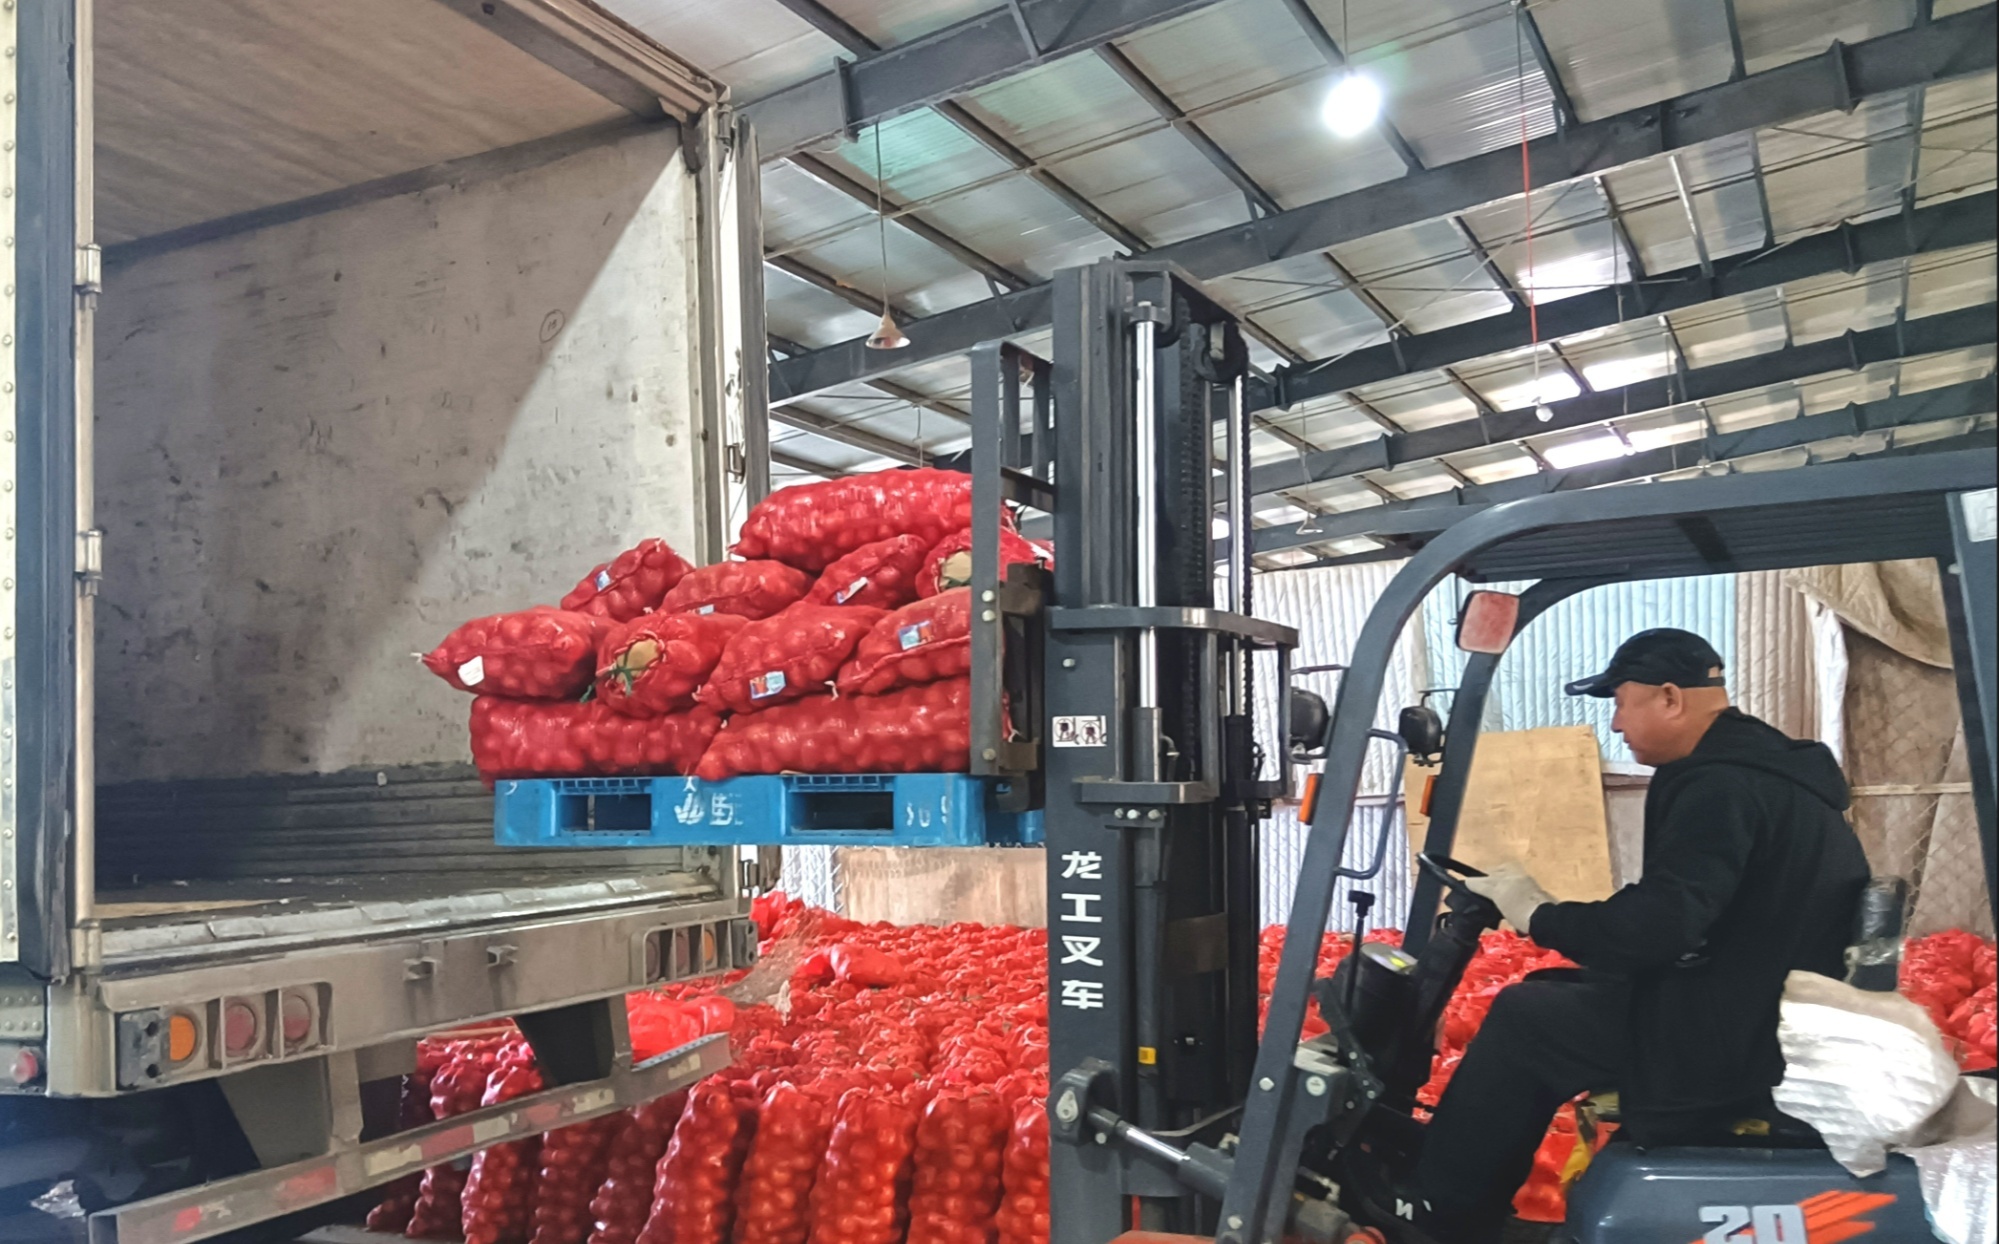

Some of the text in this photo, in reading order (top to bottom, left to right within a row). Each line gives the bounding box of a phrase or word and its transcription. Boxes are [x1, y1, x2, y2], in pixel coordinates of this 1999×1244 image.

[1061, 851, 1104, 1010] 龙工叉车
[1699, 1204, 1808, 1244] 20
